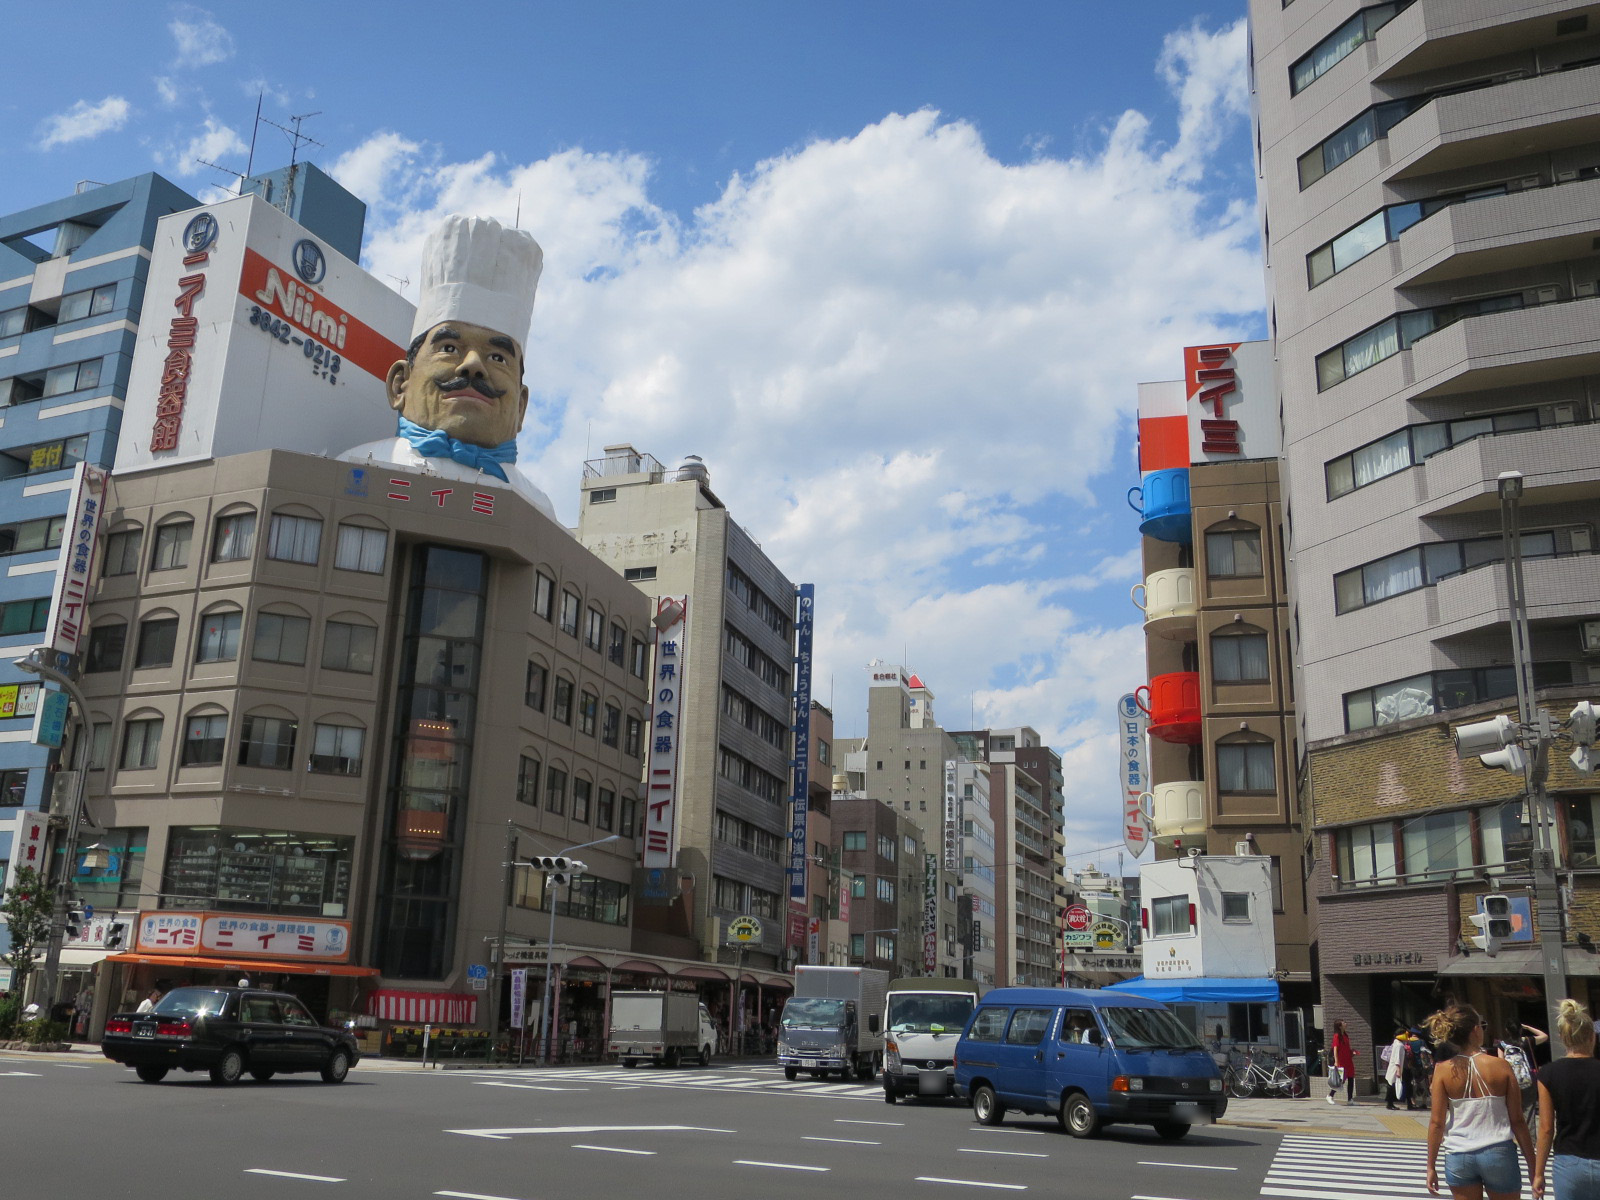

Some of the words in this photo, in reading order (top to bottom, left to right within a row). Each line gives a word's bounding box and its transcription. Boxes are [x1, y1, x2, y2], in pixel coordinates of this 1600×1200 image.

[255, 267, 348, 350] Niimi
[150, 251, 208, 453] ニイミ食器館
[249, 305, 341, 374] 3842-0213
[312, 365, 337, 386] ニイミ
[1197, 347, 1240, 454] ニイミ
[29, 445, 64, 470] 受付
[387, 478, 495, 516] ニイミ
[72, 498, 98, 575] 世界の食器
[60, 578, 85, 643] ニイミ
[655, 640, 678, 754] 世界の食器
[1126, 722, 1140, 786] 日本の食器
[648, 768, 671, 853] ニイミ
[1127, 790, 1144, 842] ニイミ
[926, 855, 936, 896] ショーケース
[156, 928, 196, 946] ニイミ
[159, 918, 197, 928] 世界の食器
[216, 930, 315, 952] ニイミ
[218, 920, 315, 934] 世界の食器・調理器具
[1069, 914, 1086, 923] 消火栓
